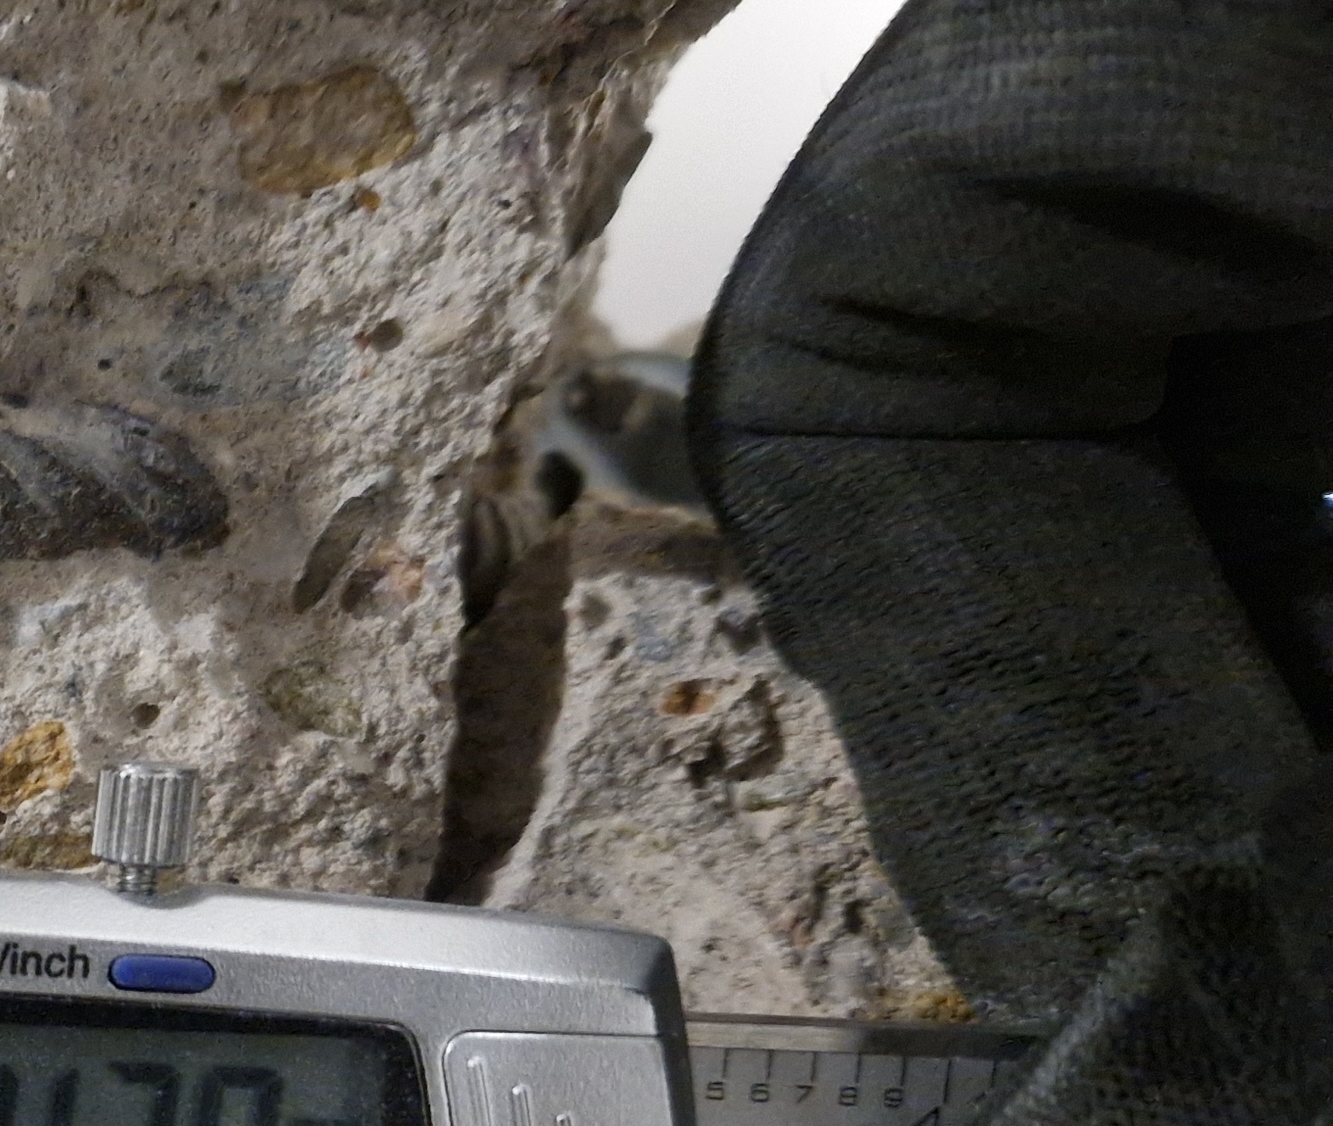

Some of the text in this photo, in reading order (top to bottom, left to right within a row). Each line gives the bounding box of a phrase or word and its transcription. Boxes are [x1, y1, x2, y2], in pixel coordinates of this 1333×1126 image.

[705, 1080, 725, 1101] 5
[749, 1082, 771, 1104] 6
[794, 1084, 815, 1105] 7
